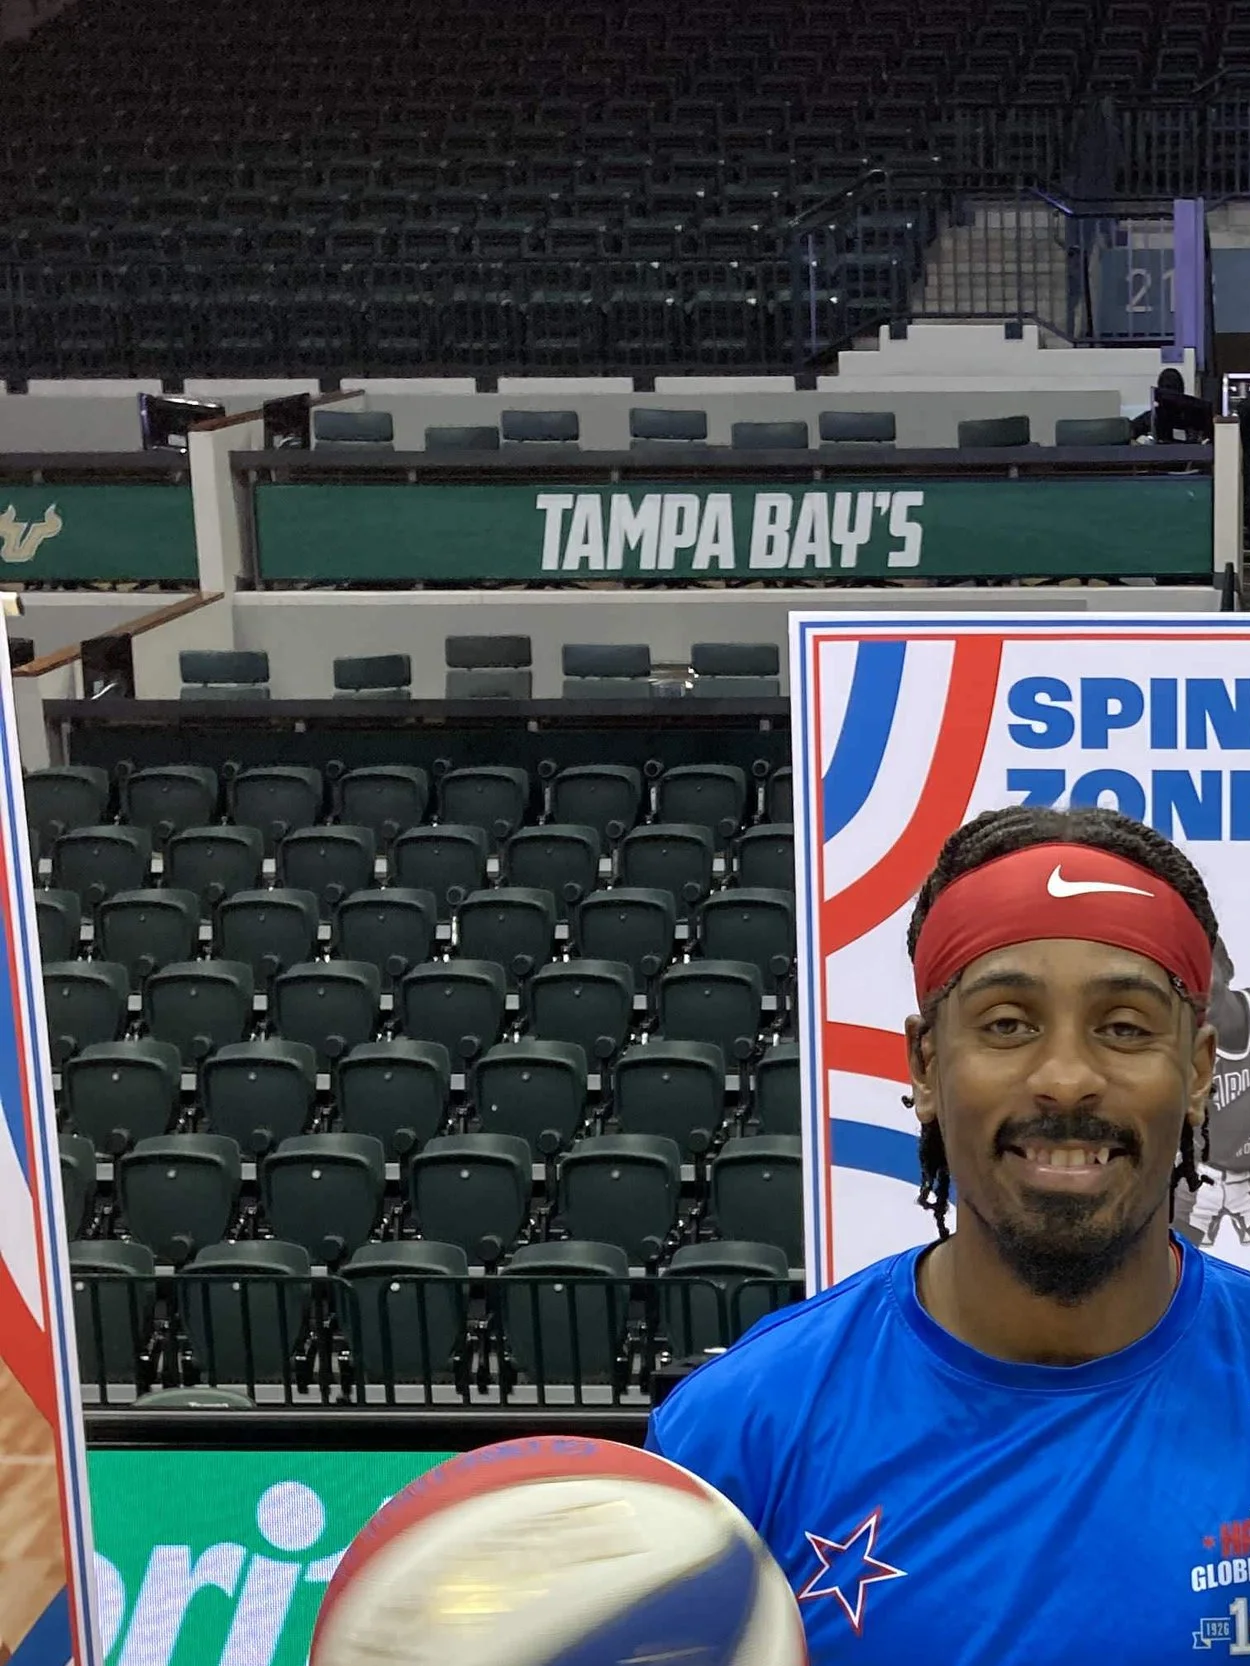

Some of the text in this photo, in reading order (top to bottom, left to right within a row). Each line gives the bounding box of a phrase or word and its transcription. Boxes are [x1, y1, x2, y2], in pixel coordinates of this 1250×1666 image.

[535, 491, 924, 570] TAMPA BAY'S
[1205, 1621, 1230, 1636] 1926
